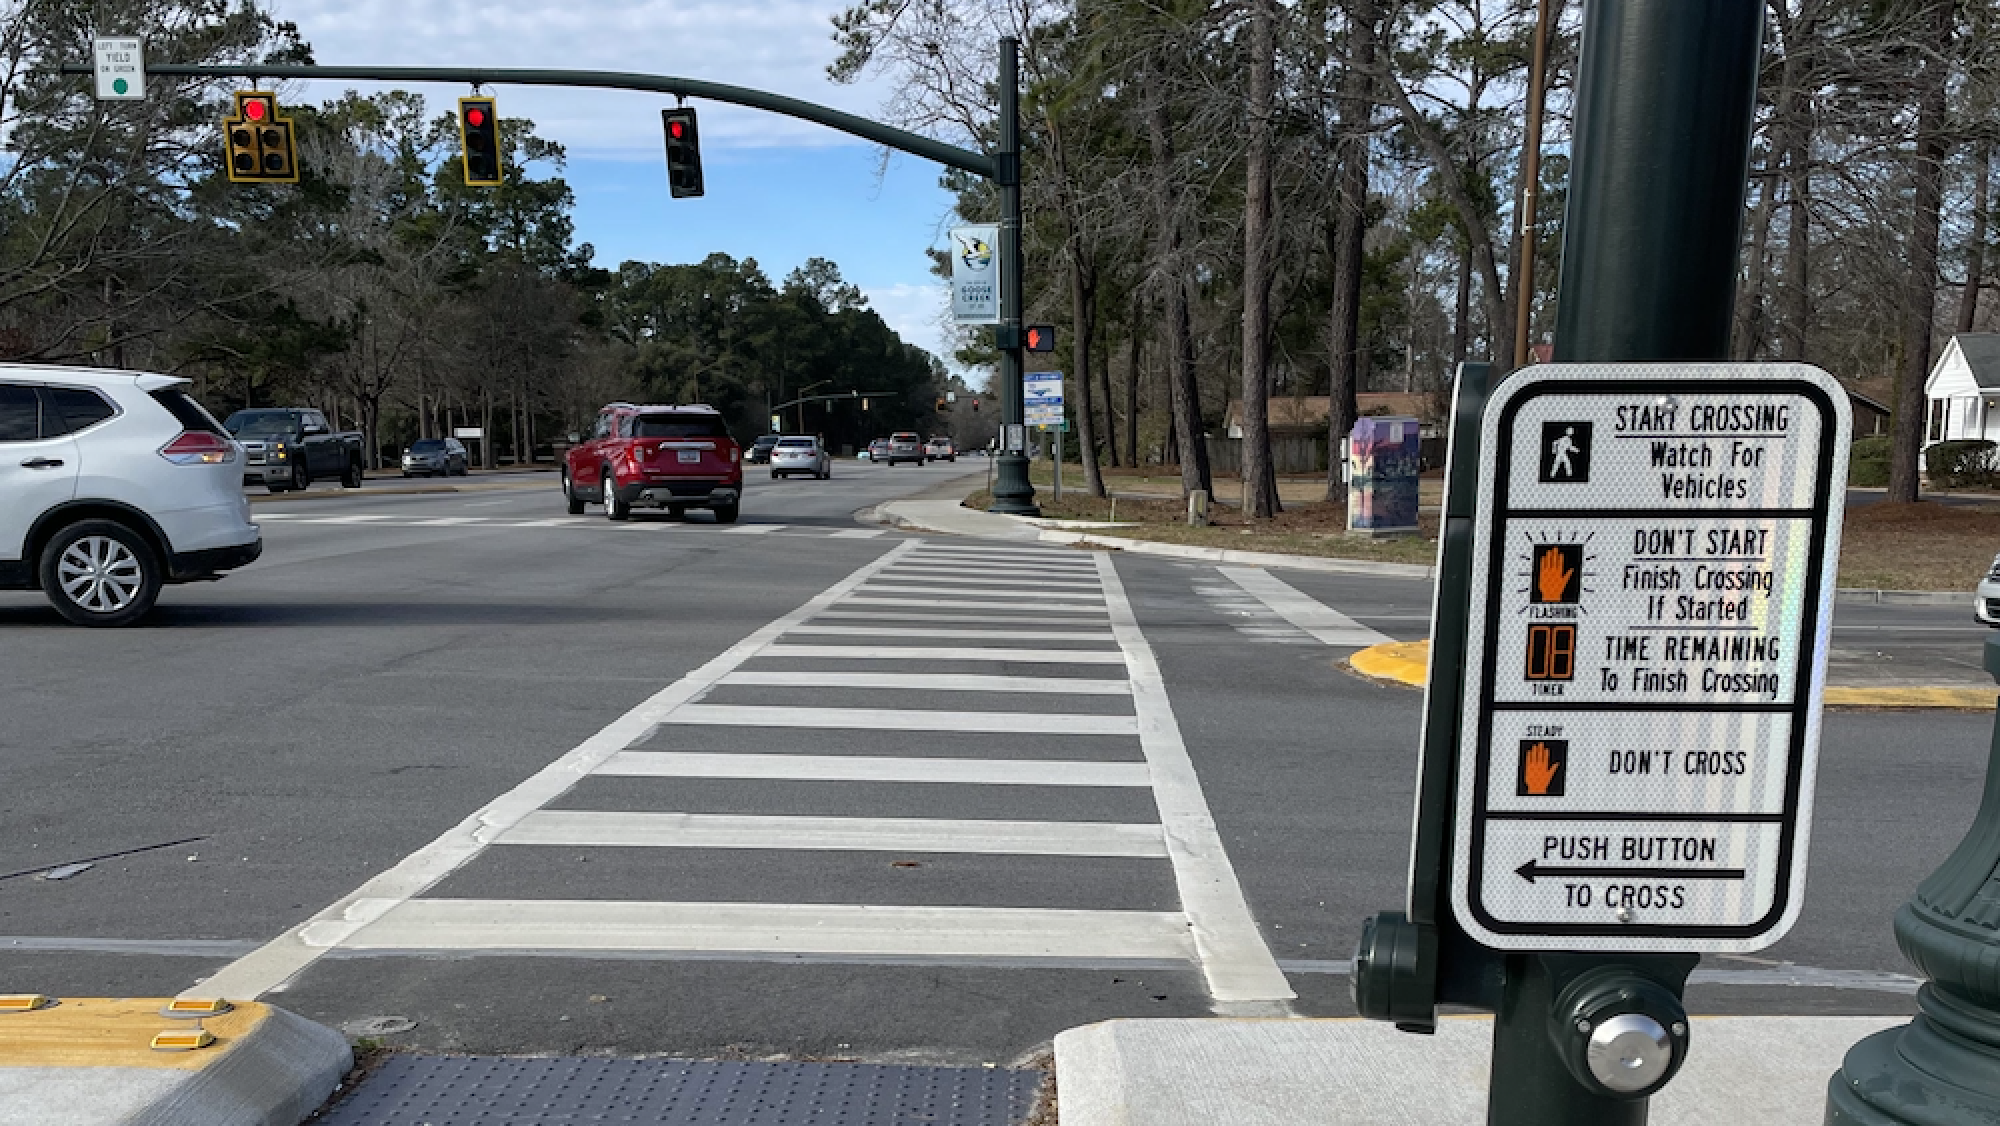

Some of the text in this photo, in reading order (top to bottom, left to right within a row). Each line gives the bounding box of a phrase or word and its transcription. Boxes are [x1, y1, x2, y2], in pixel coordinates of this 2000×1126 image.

[1615, 405, 1789, 432] START CROSSING
[1650, 442, 1765, 468] Watch For
[1661, 474, 1748, 500] Vehicles
[1633, 529, 1769, 555] DON'T START
[1622, 565, 1774, 597] Finish Crossing
[1530, 606, 1577, 618] FLASHING
[1647, 596, 1748, 622] If Started
[1605, 635, 1780, 662] TIME REMAINING
[1532, 683, 1565, 696] TIMER
[1600, 667, 1779, 701] To Finish Crossing
[1526, 725, 1564, 738] STEADY
[1609, 750, 1747, 775] DON'T CROSS
[1542, 836, 1716, 861] PUSH BUTTON
[1565, 884, 1686, 909] TO CROSS
